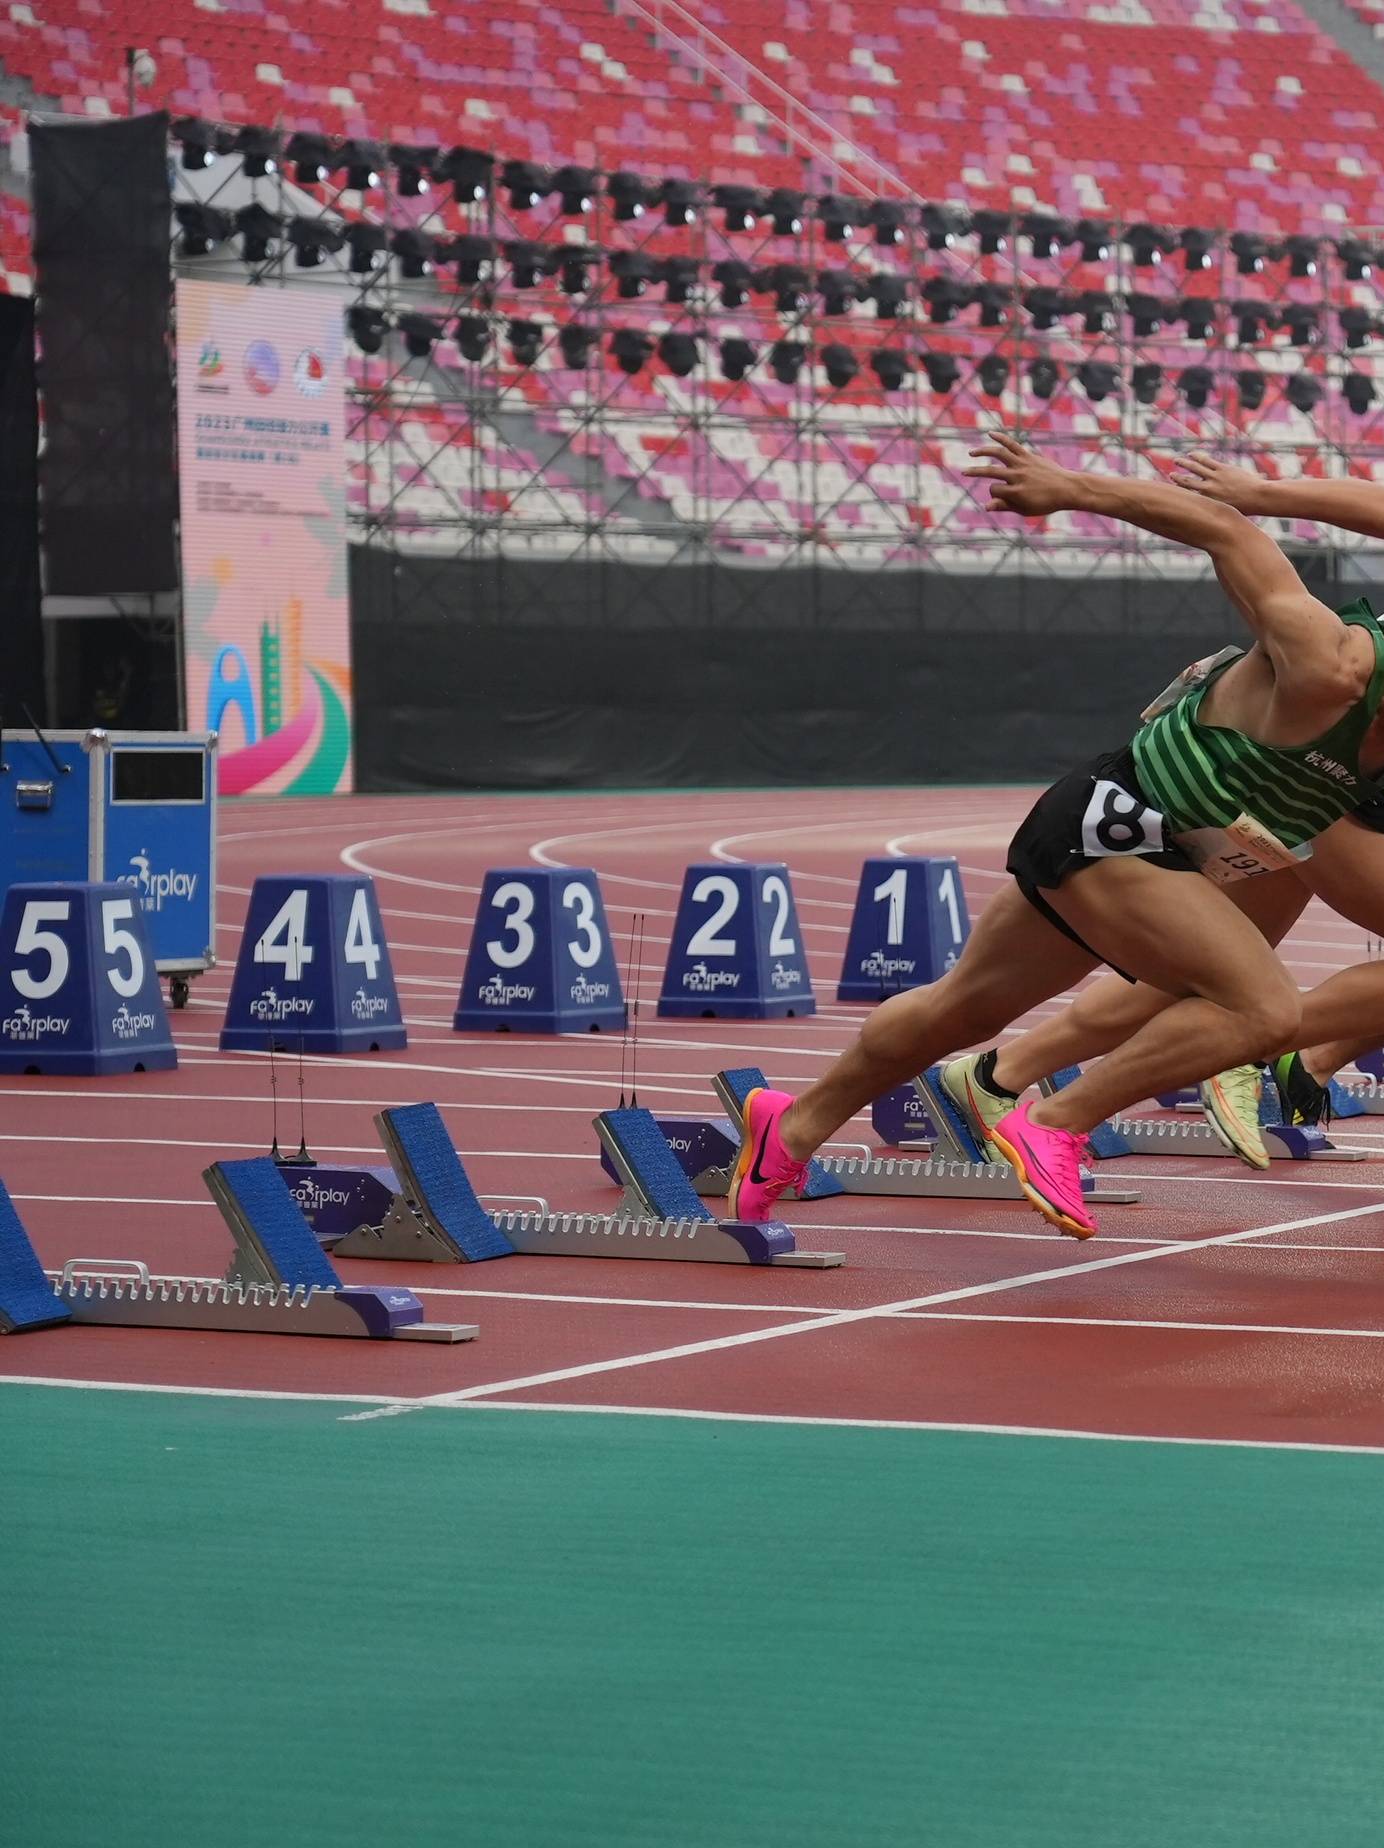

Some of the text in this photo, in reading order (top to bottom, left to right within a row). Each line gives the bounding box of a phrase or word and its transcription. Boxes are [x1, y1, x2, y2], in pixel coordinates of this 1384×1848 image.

[1096, 788, 1146, 852] 8
[10, 900, 71, 999] 5
[102, 899, 144, 998] 5
[254, 889, 313, 981] 4
[344, 888, 381, 980] 4
[486, 881, 535, 969] 3
[562, 881, 602, 969] 3
[686, 875, 740, 957] 2
[762, 875, 796, 958] 2
[874, 869, 907, 946] 1
[938, 868, 963, 944] 1
